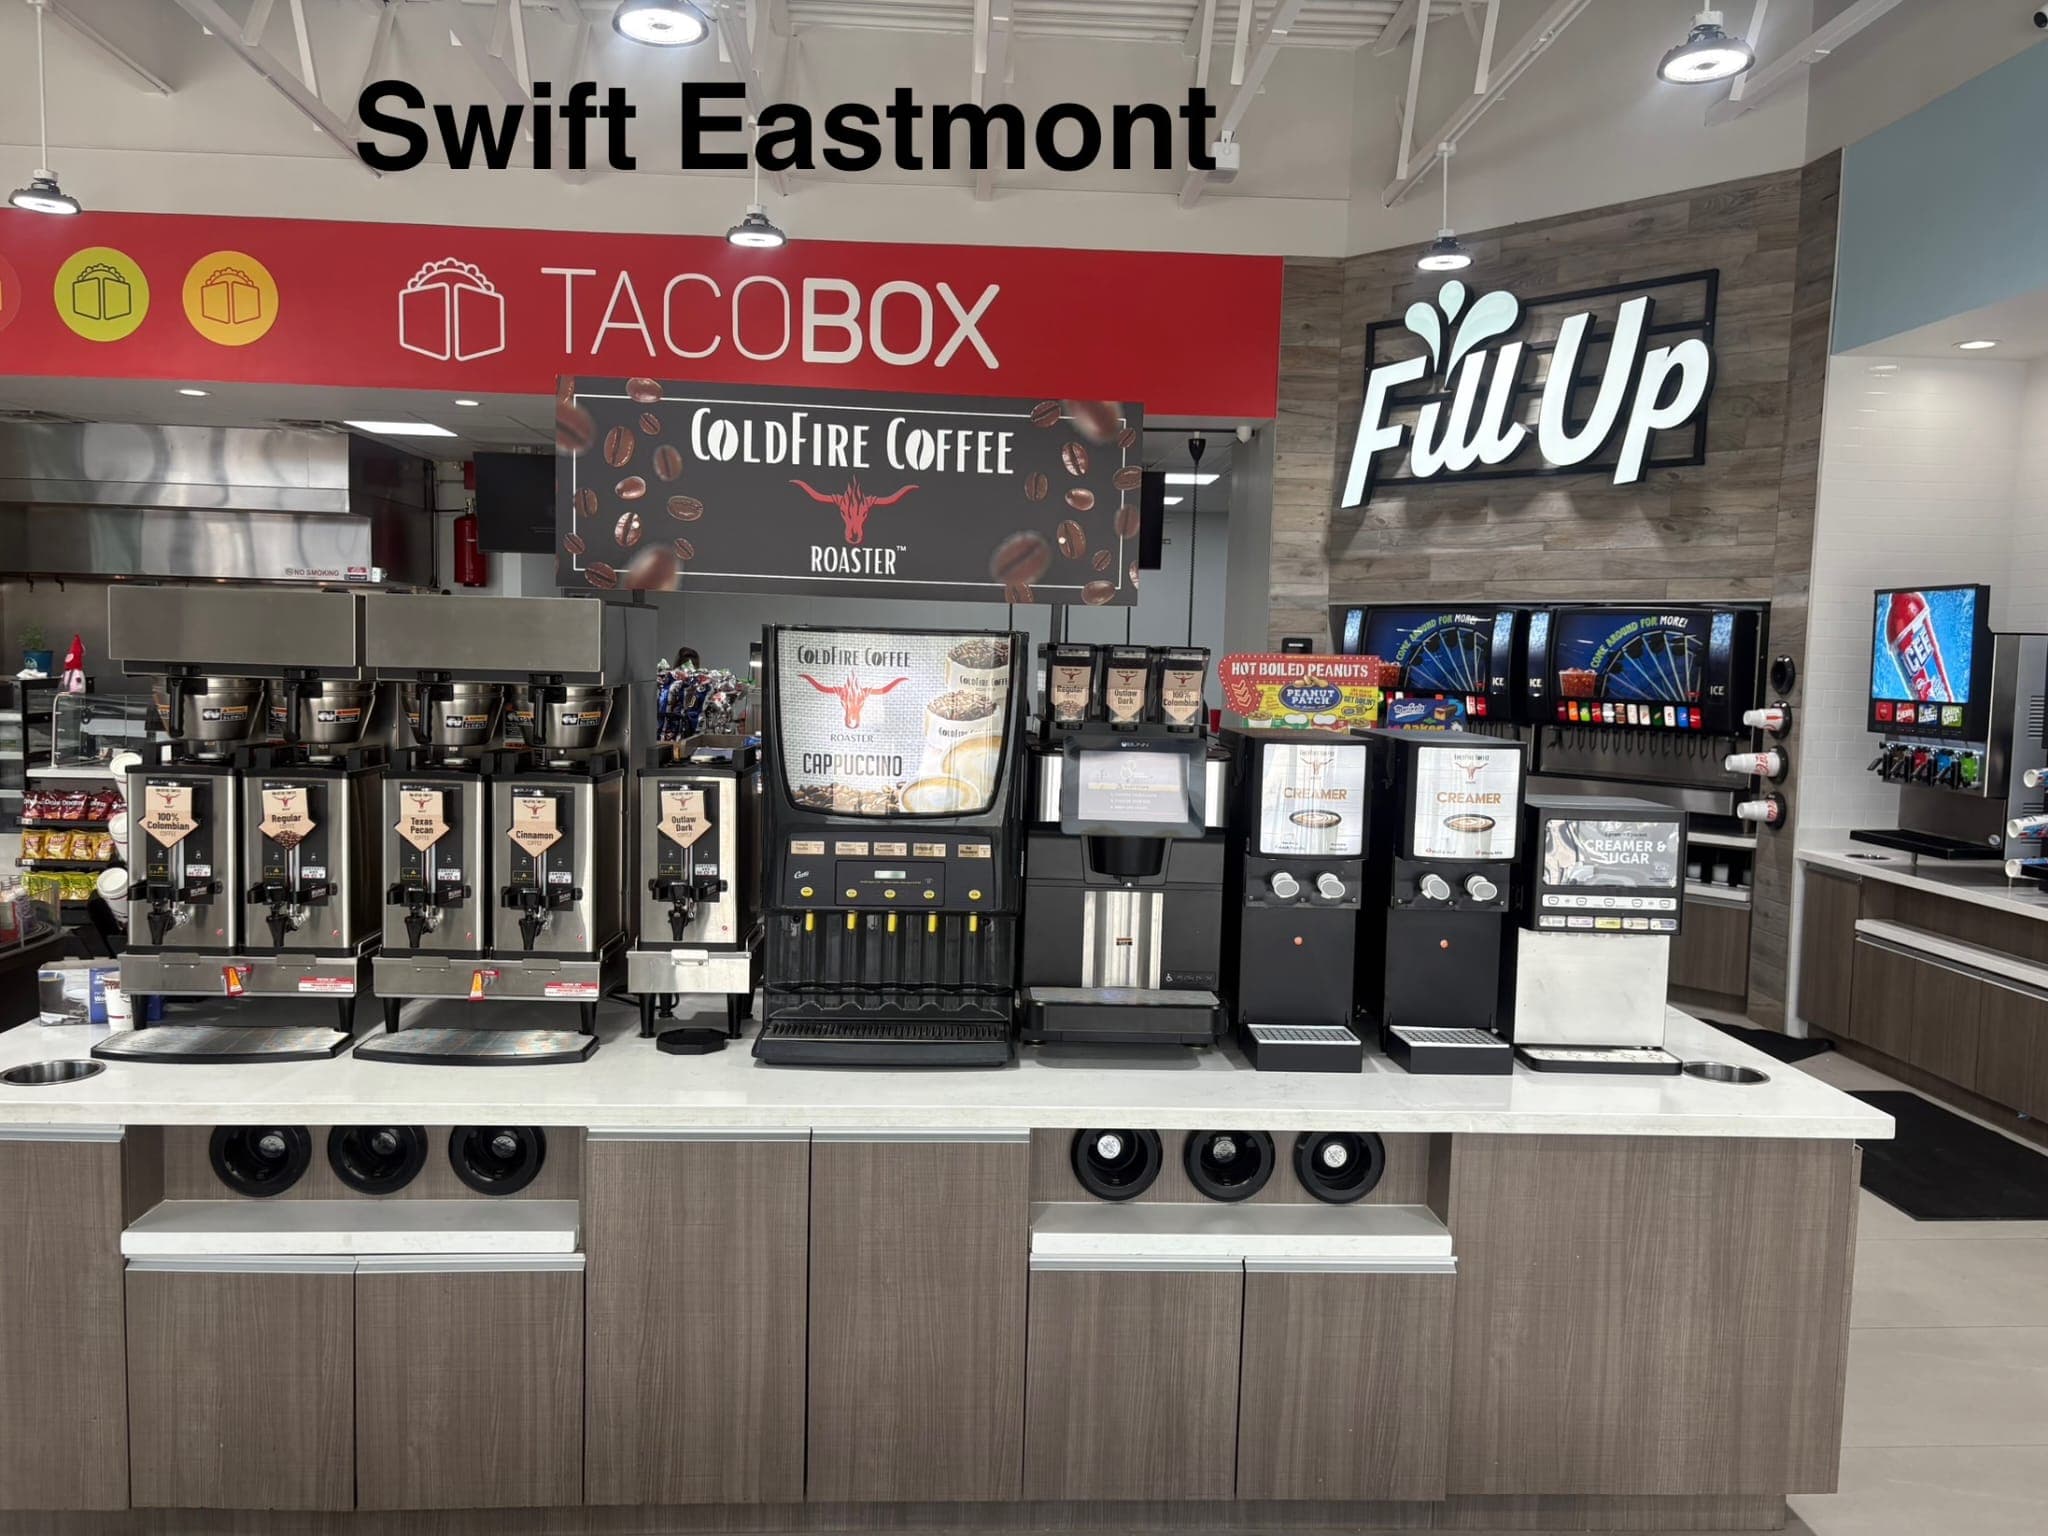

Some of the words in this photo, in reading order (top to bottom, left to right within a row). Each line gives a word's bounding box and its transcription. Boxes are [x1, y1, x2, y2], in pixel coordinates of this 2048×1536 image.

[541, 266, 1001, 370] TACOBOX
[1538, 296, 1711, 486] Up
[886, 417, 1014, 475] COFFEE
[294, 568, 305, 576] NO
[306, 568, 339, 577] SMOKING
[1395, 640, 1412, 661] COME
[1438, 614, 1453, 625] FOR
[1590, 645, 1609, 668] COME
[1605, 622, 1639, 647] AROUND
[1640, 616, 1659, 629] FOR
[1659, 615, 1689, 628] MORE!
[865, 648, 911, 668] COFFEE
[1231, 662, 1257, 676] HOT
[1259, 662, 1305, 677] BOILED
[1308, 663, 1369, 678] PEANUTS
[1492, 677, 1505, 686] ICE
[1529, 678, 1542, 688] ICE
[1056, 684, 1084, 696] Regular
[1114, 689, 1138, 698] Outlaw
[1172, 691, 1191, 699] 100%
[1286, 688, 1335, 698] PEANUT
[1710, 685, 1725, 696] ICE
[1117, 697, 1134, 705] Dark
[1163, 698, 1199, 707] Colombian
[1291, 697, 1331, 706] PATCH
[830, 733, 874, 743] ROASTER
[802, 753, 903, 777] CAPPUCCINO
[1284, 787, 1348, 800] CREAMER
[1437, 791, 1502, 804] CREAMER
[157, 812, 179, 822] 100%
[271, 814, 302, 825] Regular
[410, 817, 433, 827] Texas
[671, 816, 697, 825] Outlaw
[147, 821, 190, 831] Colombian
[410, 826, 434, 834] Pecan
[675, 823, 693, 832] Dark
[516, 830, 554, 840] Cinnamon
[1584, 841, 1653, 853] CREAMER
[1656, 841, 1667, 853] &
[1600, 852, 1650, 865] SUGAR
